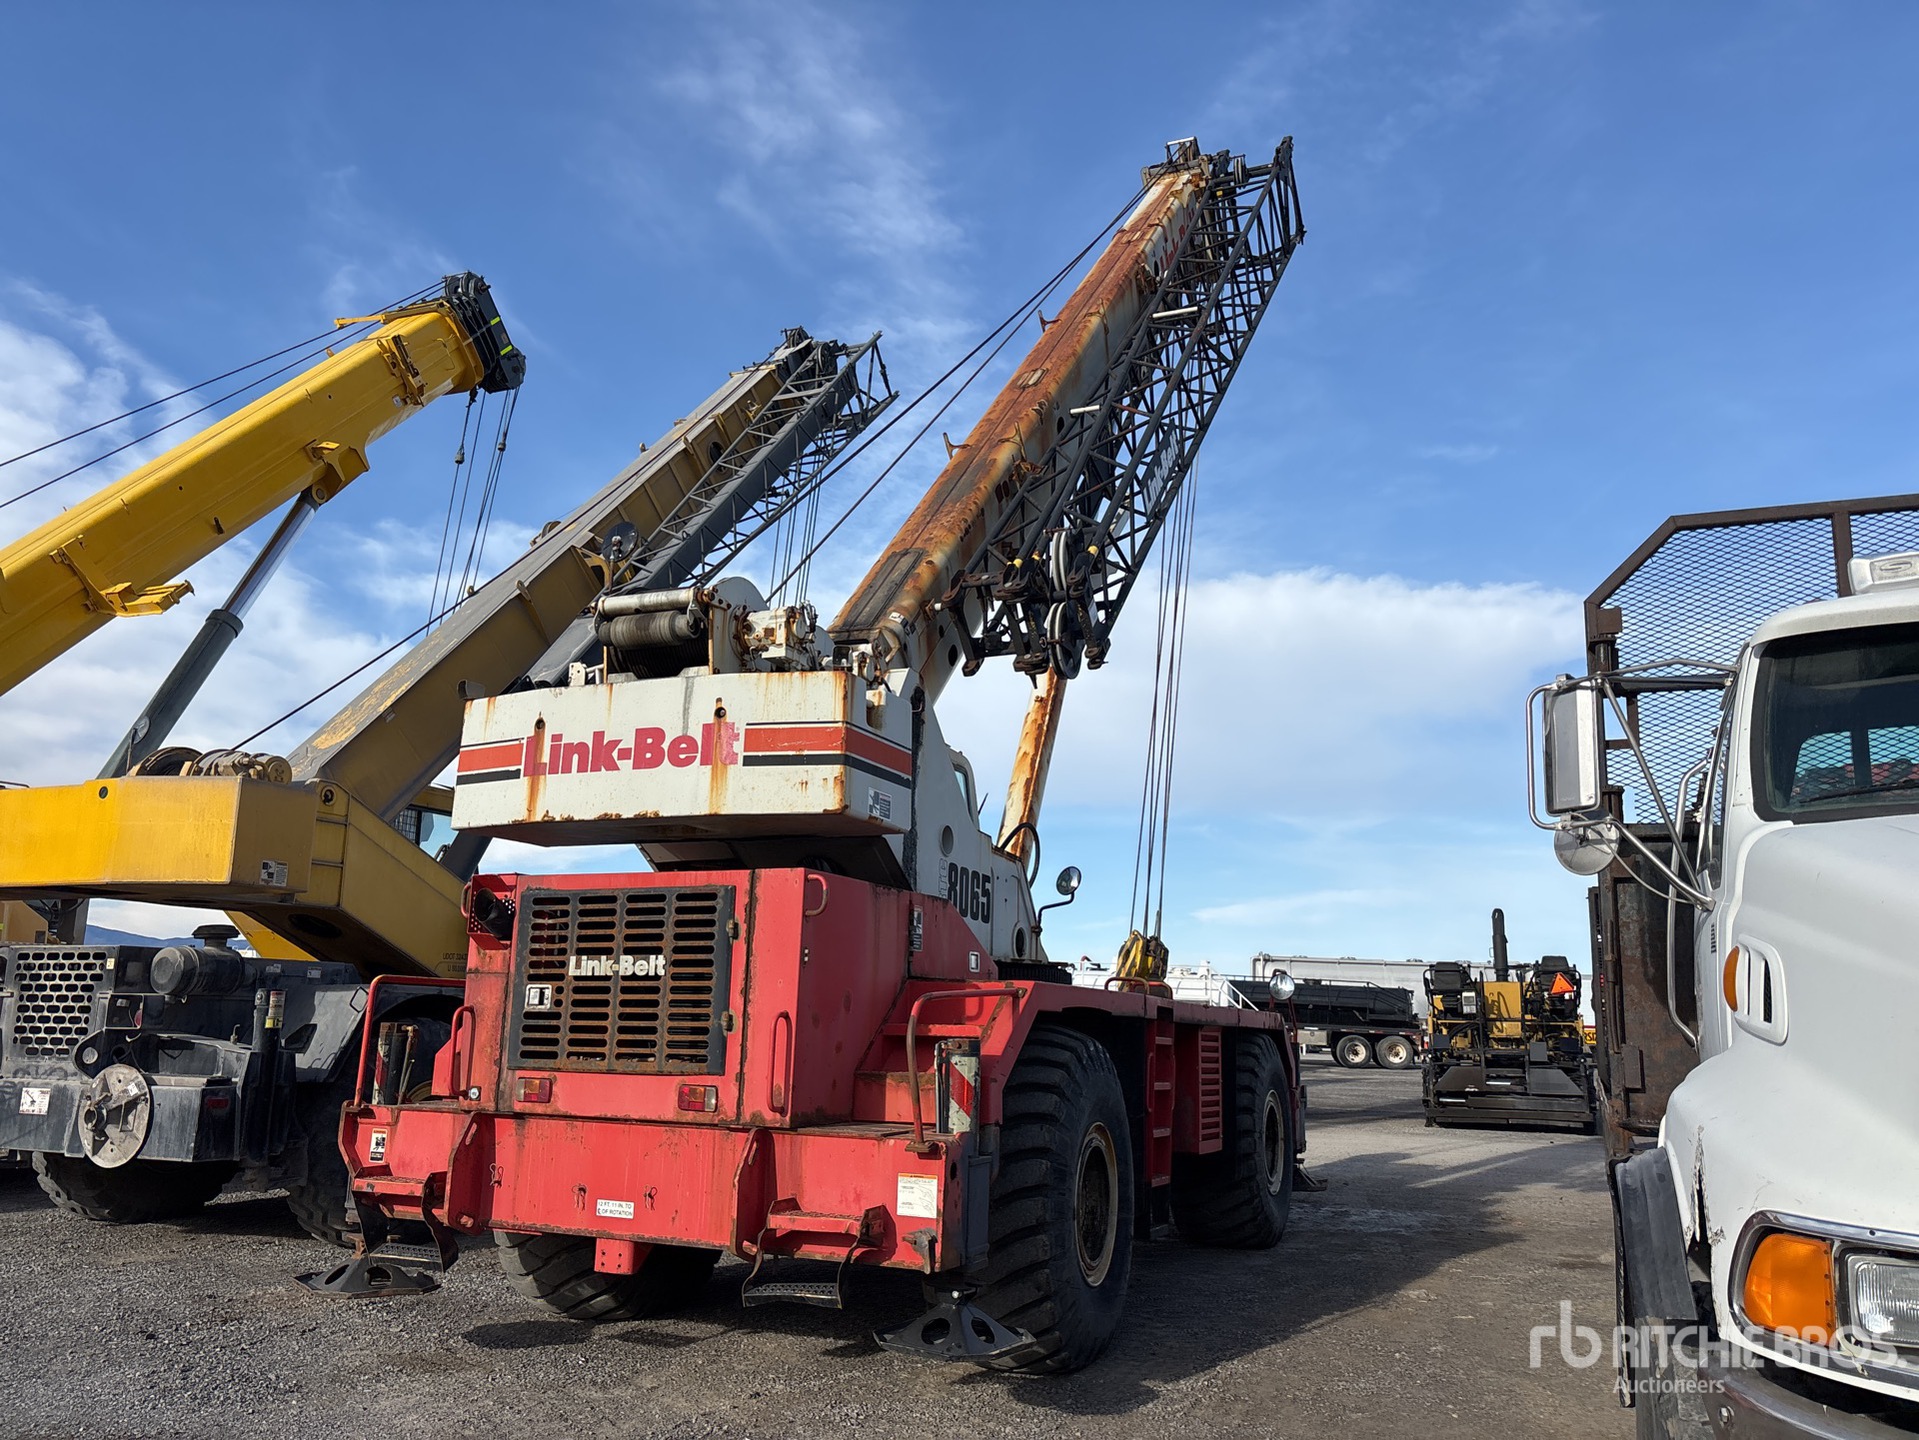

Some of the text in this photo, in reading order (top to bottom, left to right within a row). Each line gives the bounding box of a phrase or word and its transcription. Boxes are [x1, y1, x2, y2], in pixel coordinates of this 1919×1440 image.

[523, 722, 740, 777] Link-Belt
[948, 862, 991, 924] 8065
[569, 955, 666, 976] Link-Belt
